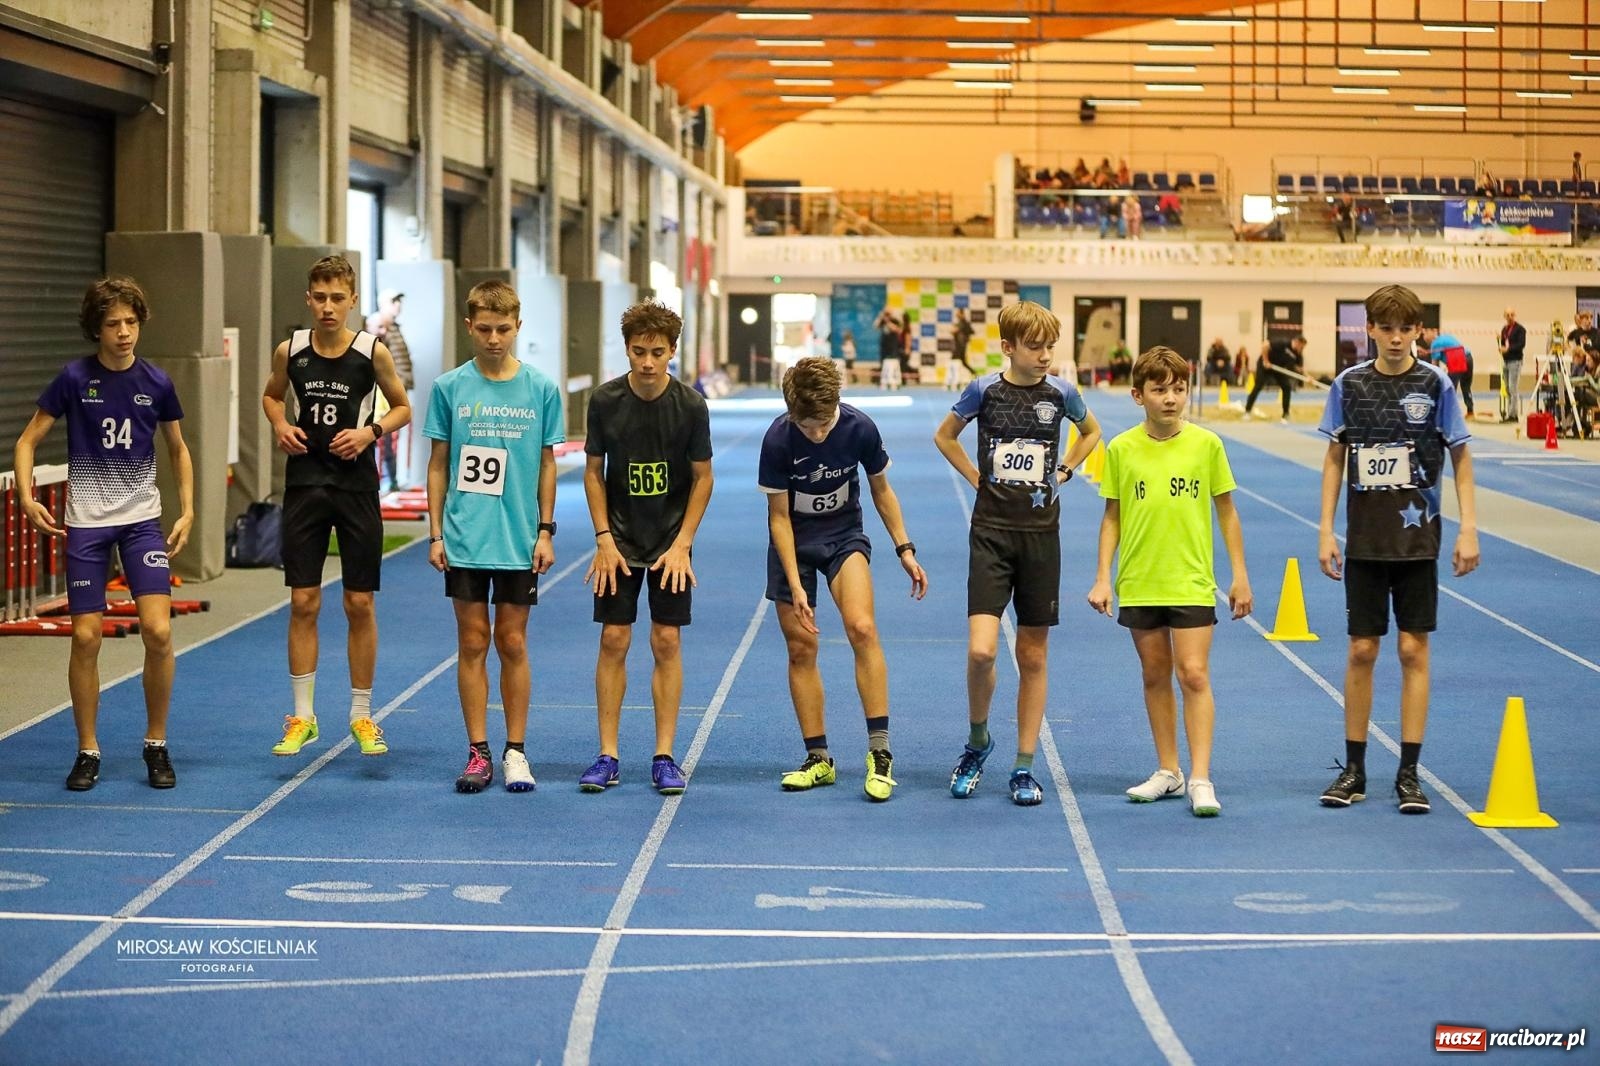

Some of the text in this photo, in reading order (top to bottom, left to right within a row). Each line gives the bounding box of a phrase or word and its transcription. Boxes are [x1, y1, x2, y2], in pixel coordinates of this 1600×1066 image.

[305, 381, 325, 390] MKS
[330, 381, 350, 393] SMS
[310, 403, 338, 426] 18
[481, 403, 536, 420] MRÓWKA
[101, 417, 133, 450] 34
[470, 429, 486, 438] CZAS
[486, 430, 496, 438] NA
[463, 455, 501, 485] 39
[1002, 453, 1034, 471] 306
[1367, 458, 1398, 476] 307
[628, 463, 667, 494] 563
[825, 468, 842, 479] DGI
[1134, 477, 1200, 501] 16 SP-15
[812, 493, 838, 512] 63
